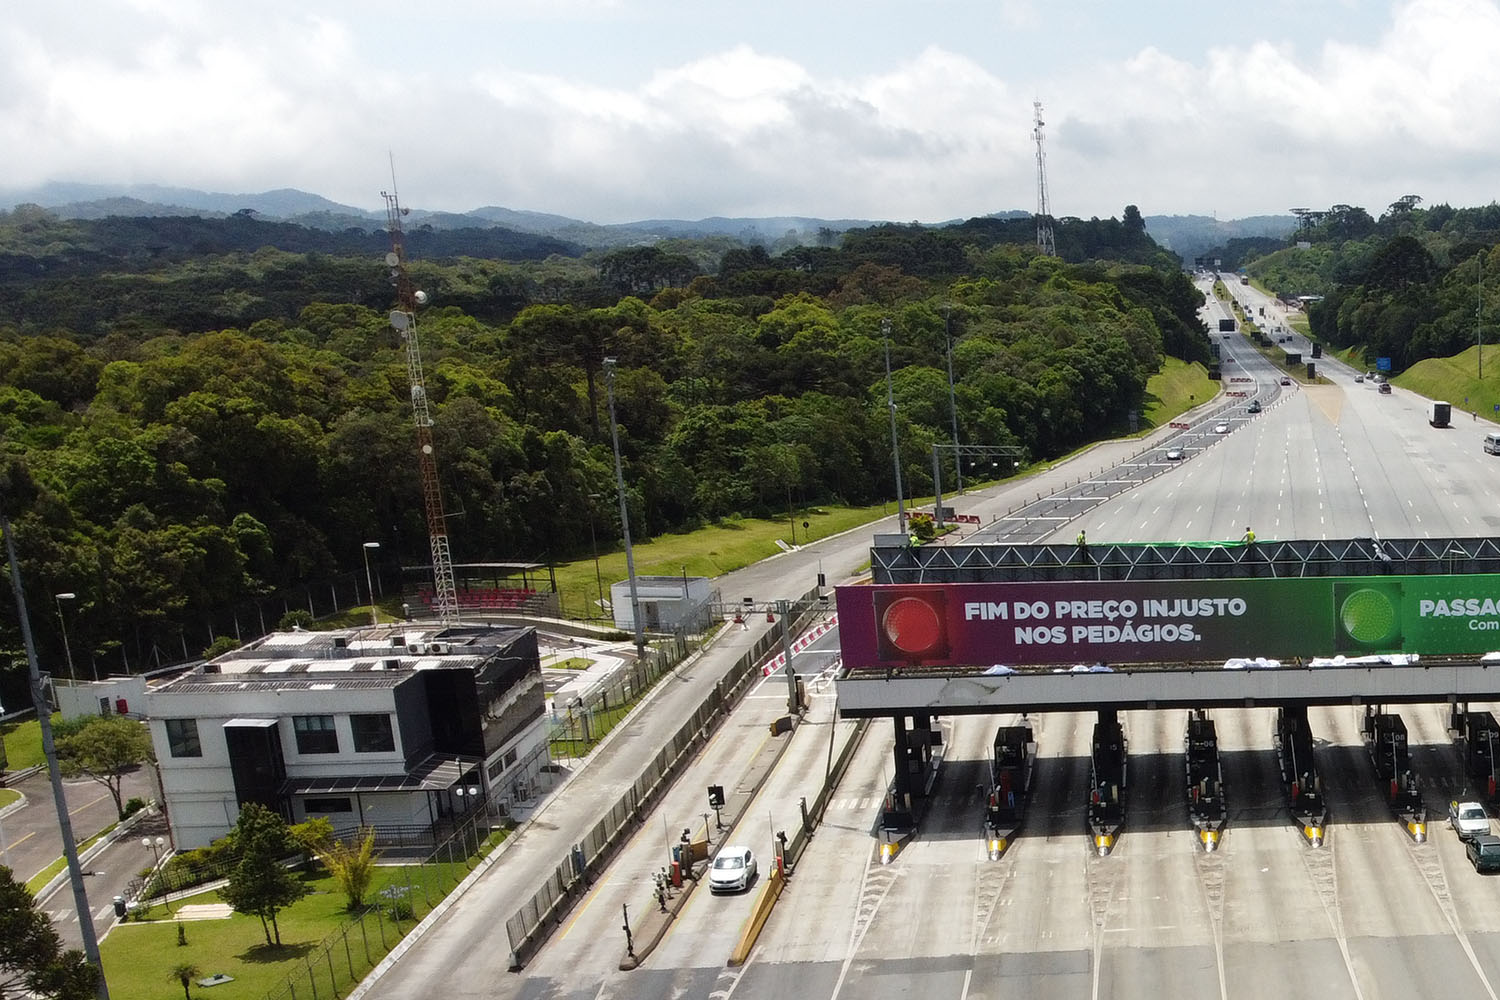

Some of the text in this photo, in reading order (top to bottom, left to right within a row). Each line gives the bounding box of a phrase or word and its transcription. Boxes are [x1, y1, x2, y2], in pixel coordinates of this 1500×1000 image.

[964, 597, 1247, 621] FIM DO PREÇO INJUSTO
[1014, 620, 1202, 644] NOS PEDÁGIOS.
[1468, 619, 1499, 630] Com
